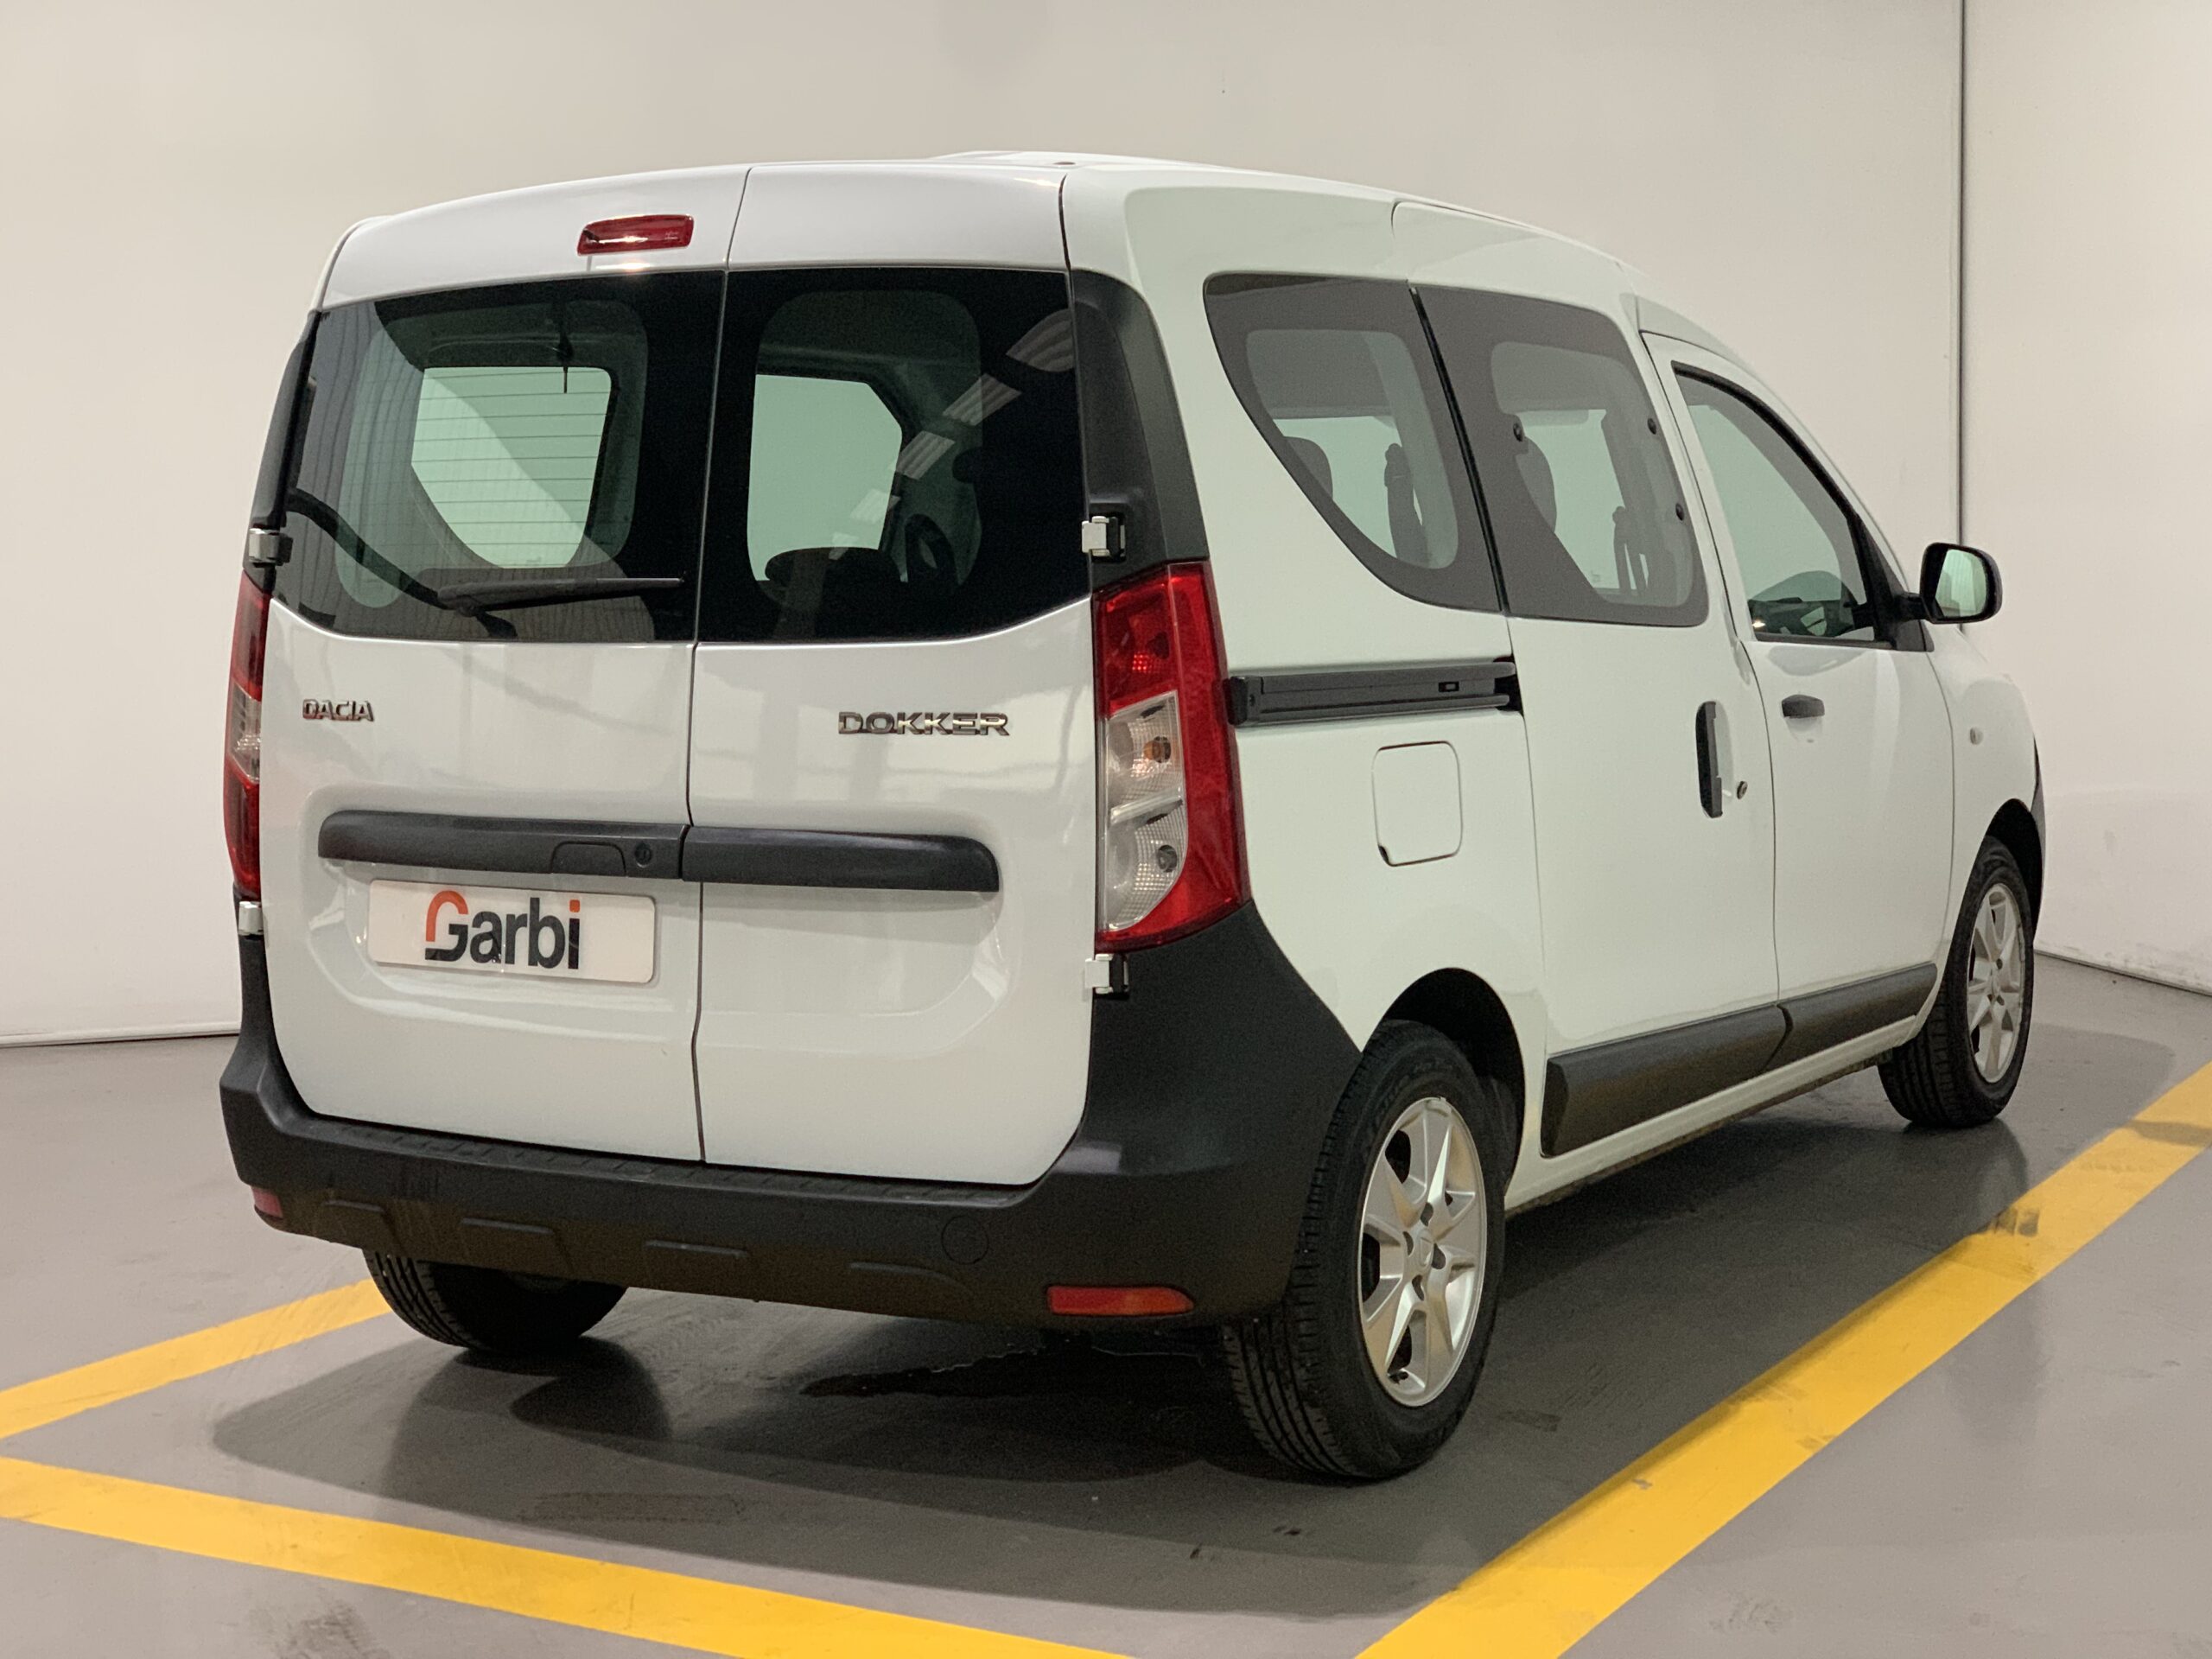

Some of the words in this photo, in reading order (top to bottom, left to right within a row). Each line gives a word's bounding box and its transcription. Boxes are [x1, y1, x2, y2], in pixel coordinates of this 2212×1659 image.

[302, 698, 374, 721] DACIA
[838, 711, 1010, 736] DOKKER
[424, 890, 581, 969] Garbi
